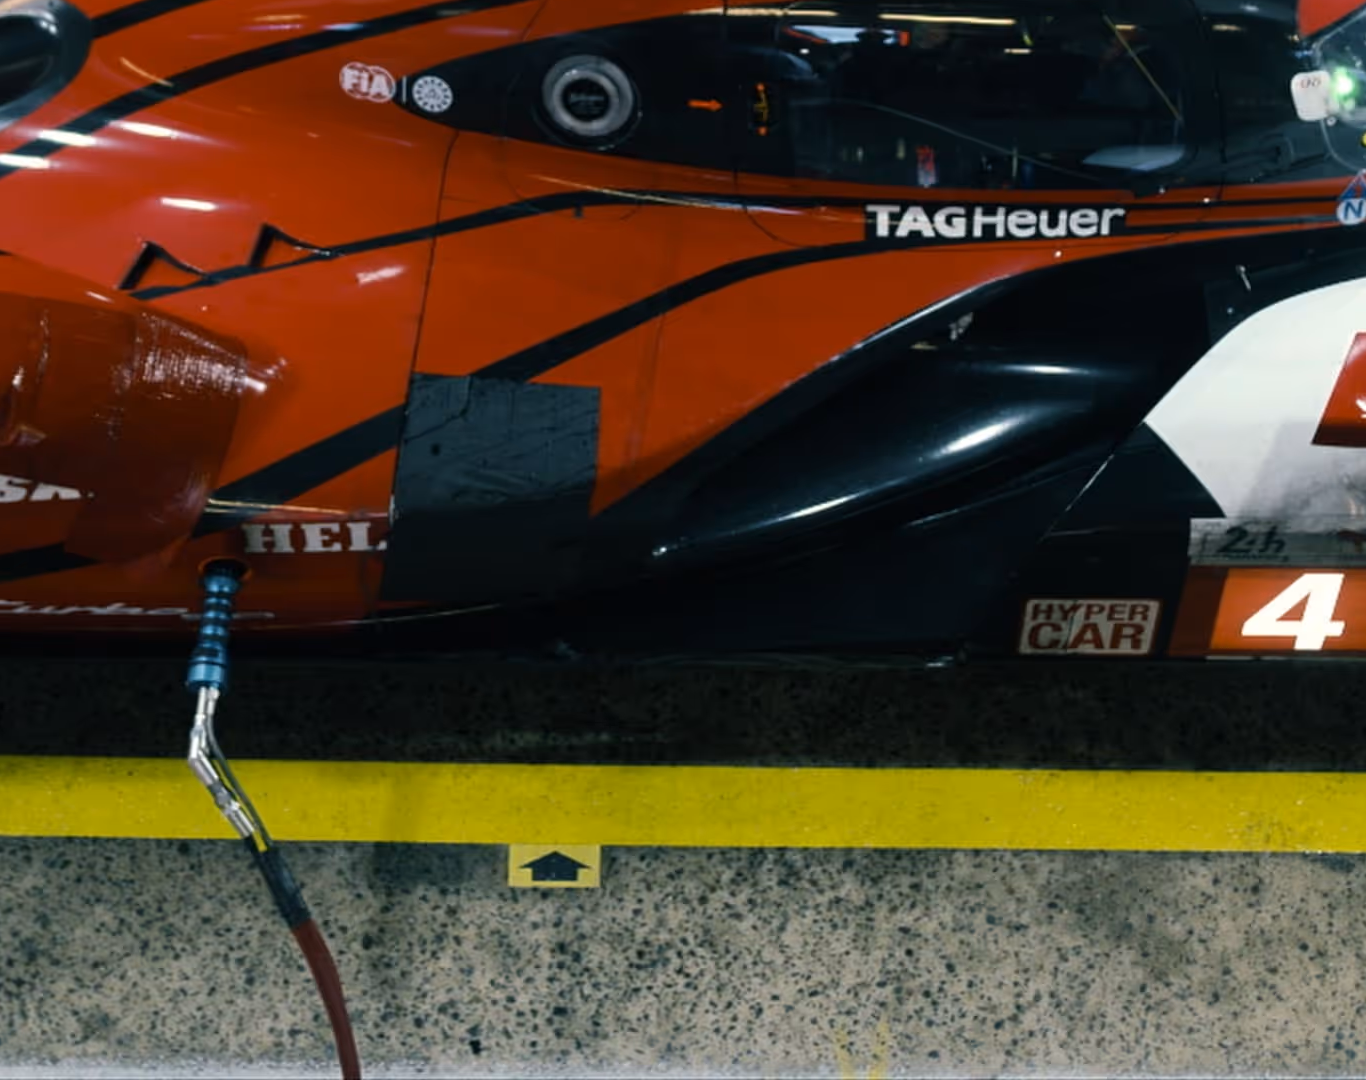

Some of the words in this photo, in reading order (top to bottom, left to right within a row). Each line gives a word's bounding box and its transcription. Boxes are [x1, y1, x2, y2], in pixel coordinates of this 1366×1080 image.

[344, 70, 392, 97] FIA
[1344, 201, 1363, 219] N
[242, 522, 387, 554] HEL
[1031, 602, 1150, 622] HYPER
[1241, 573, 1346, 650] 4
[1029, 623, 1144, 650] CAR
